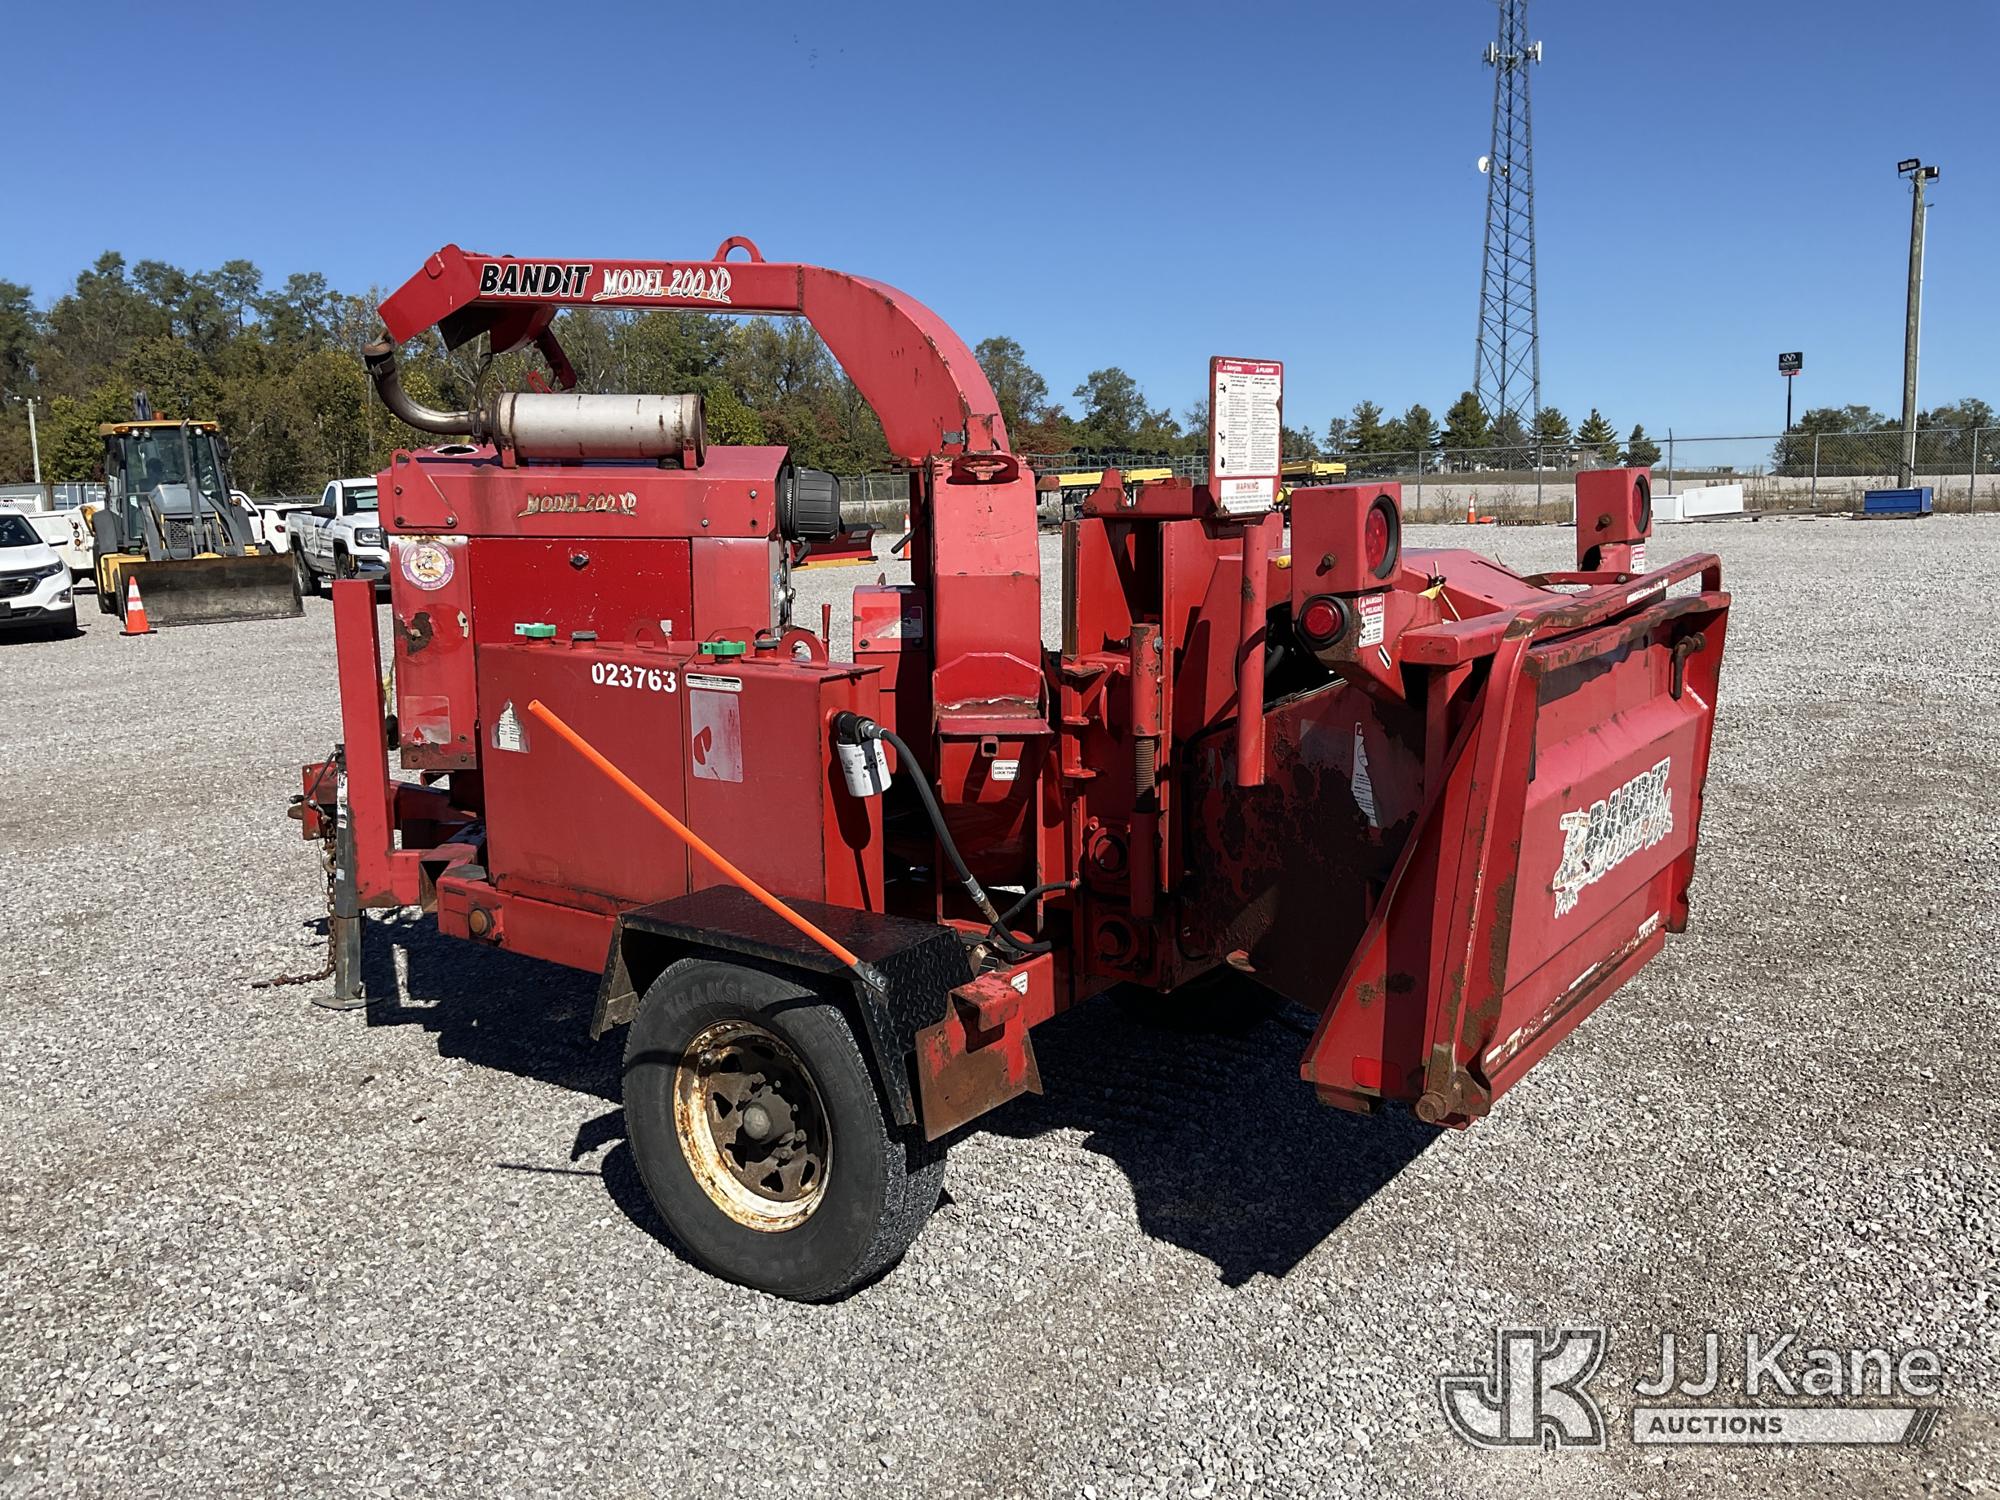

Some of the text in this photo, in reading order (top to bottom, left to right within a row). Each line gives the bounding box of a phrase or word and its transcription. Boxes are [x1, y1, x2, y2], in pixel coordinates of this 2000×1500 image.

[480, 263, 732, 301] BANDIT MODEL 200 XP
[526, 491, 637, 515] MODEL 200 XP
[591, 661, 677, 693] 023763
